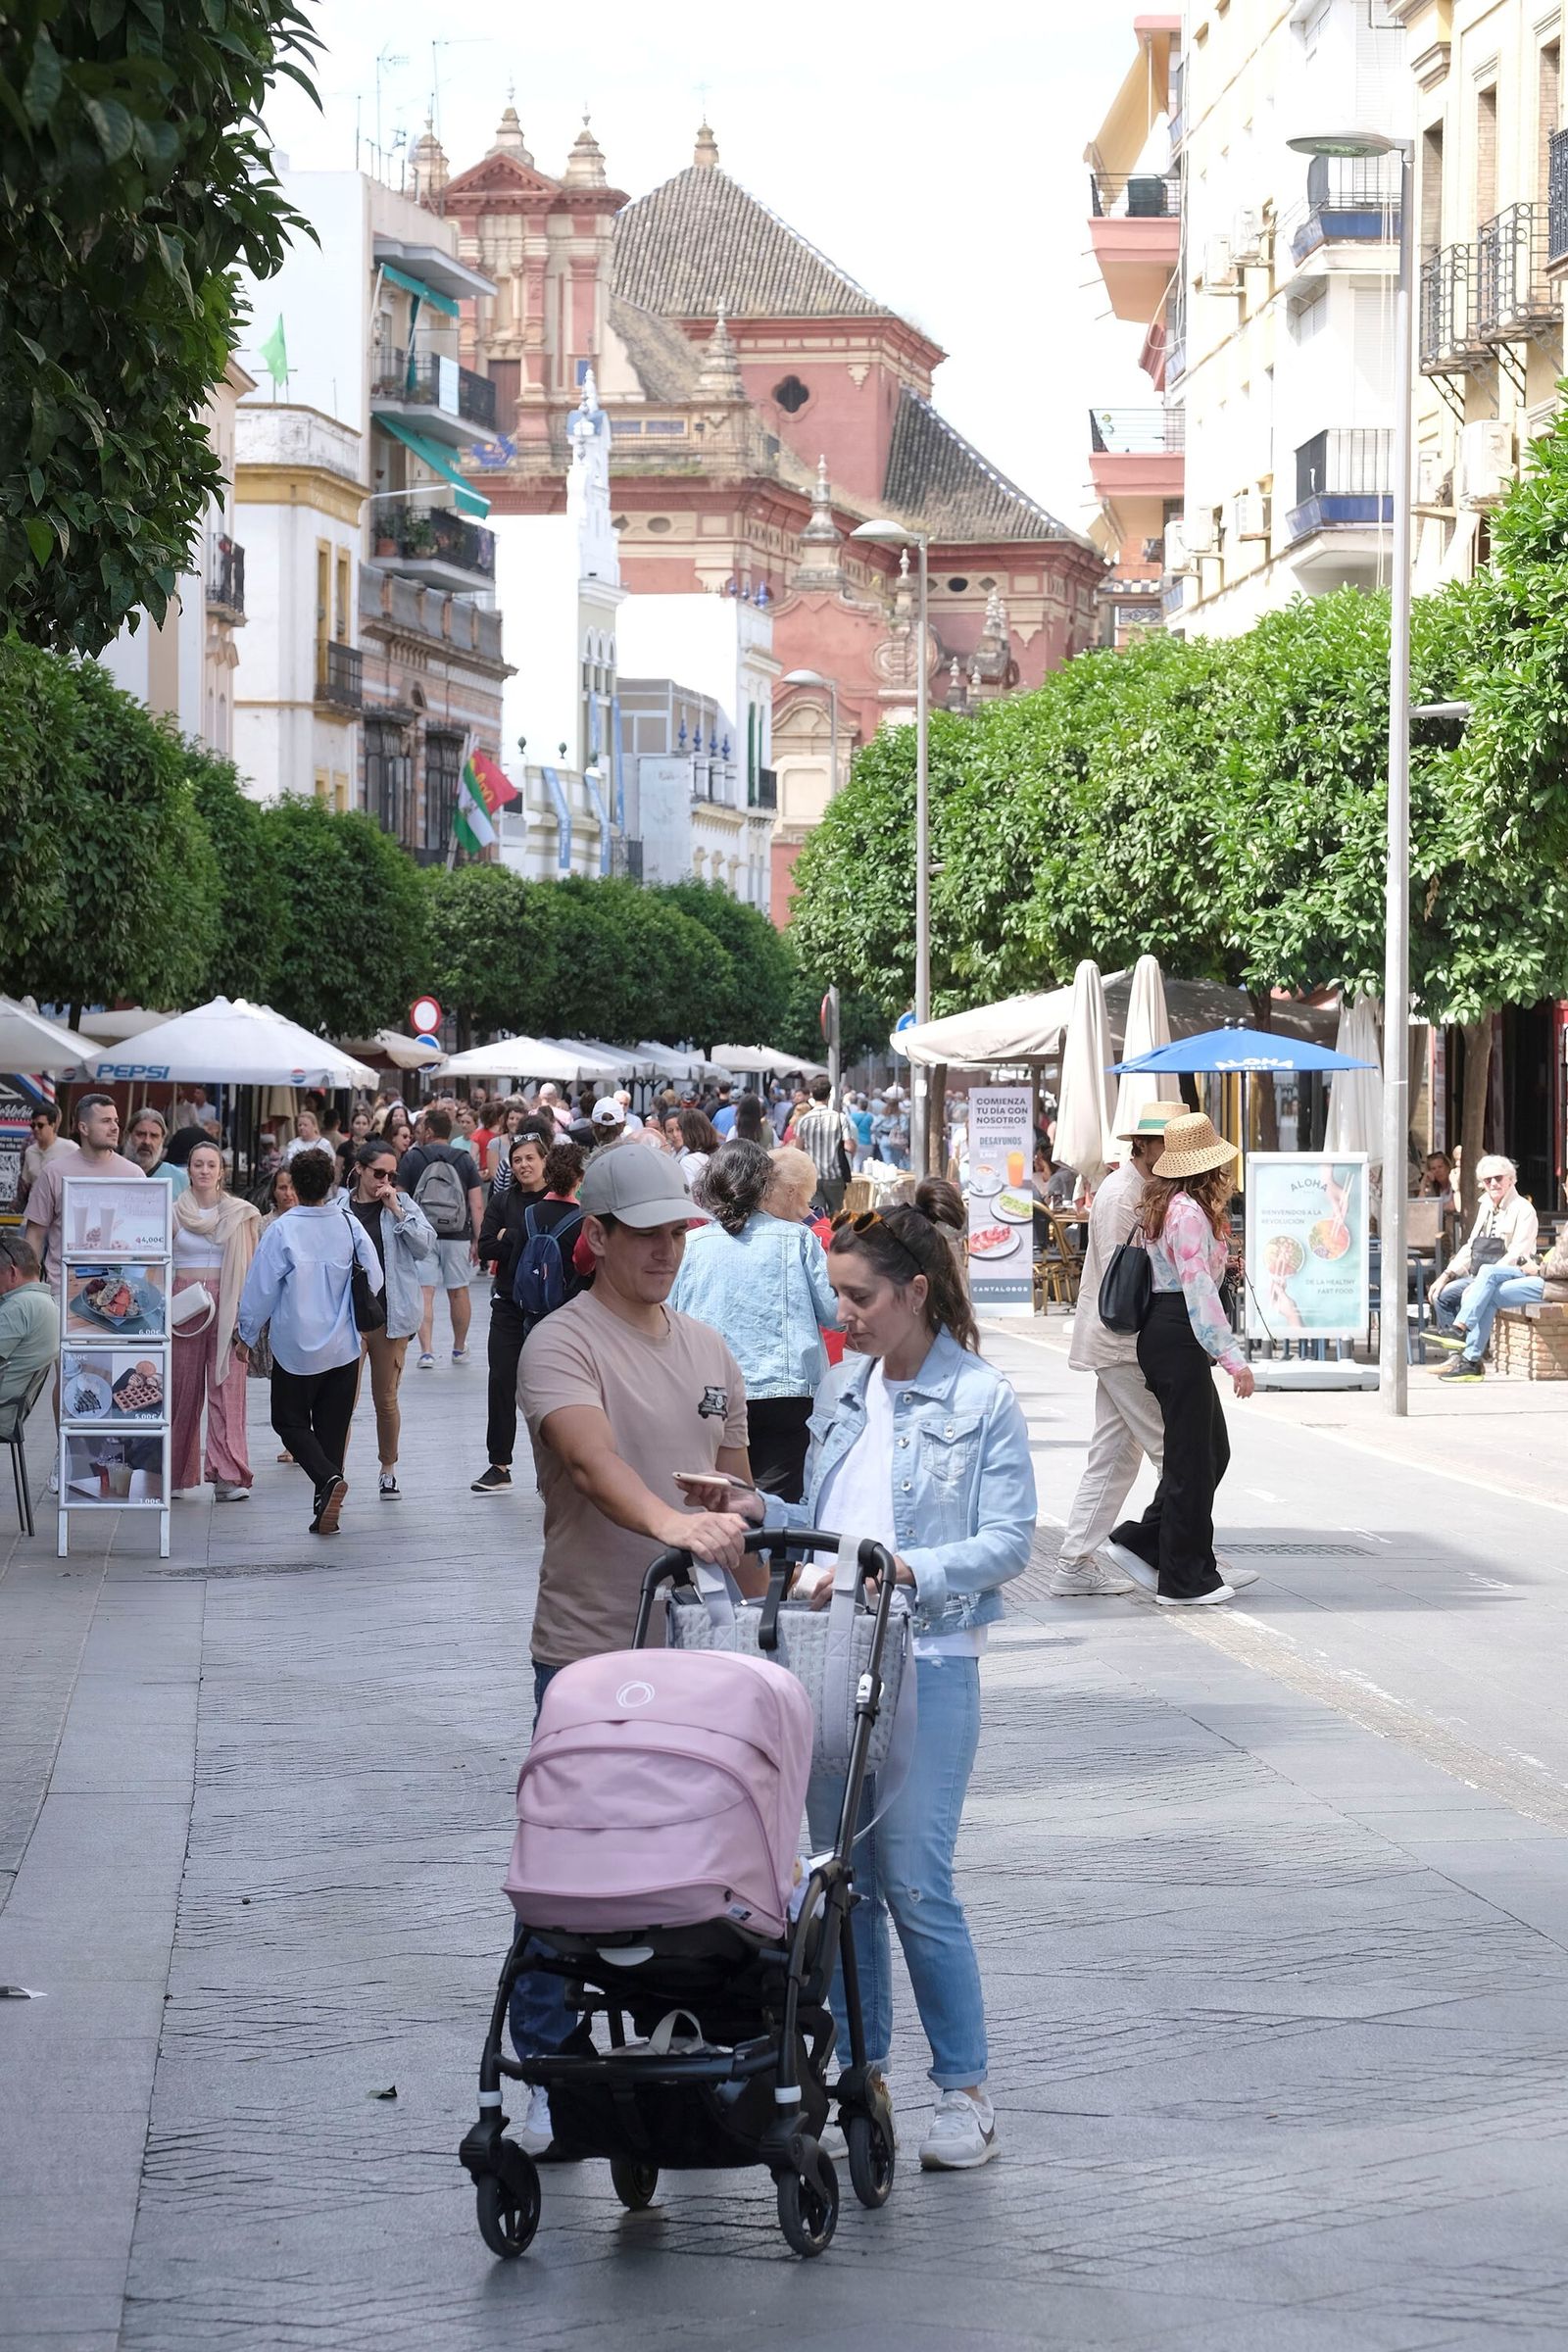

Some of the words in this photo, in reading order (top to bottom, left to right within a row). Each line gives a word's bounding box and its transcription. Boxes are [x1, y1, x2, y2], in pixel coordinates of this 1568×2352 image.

[1215, 1058, 1294, 1070] ALOHA
[97, 1064, 171, 1080] PEPSI
[990, 1105, 1005, 1114] DÍA
[1291, 1178, 1328, 1192] ALOHA
